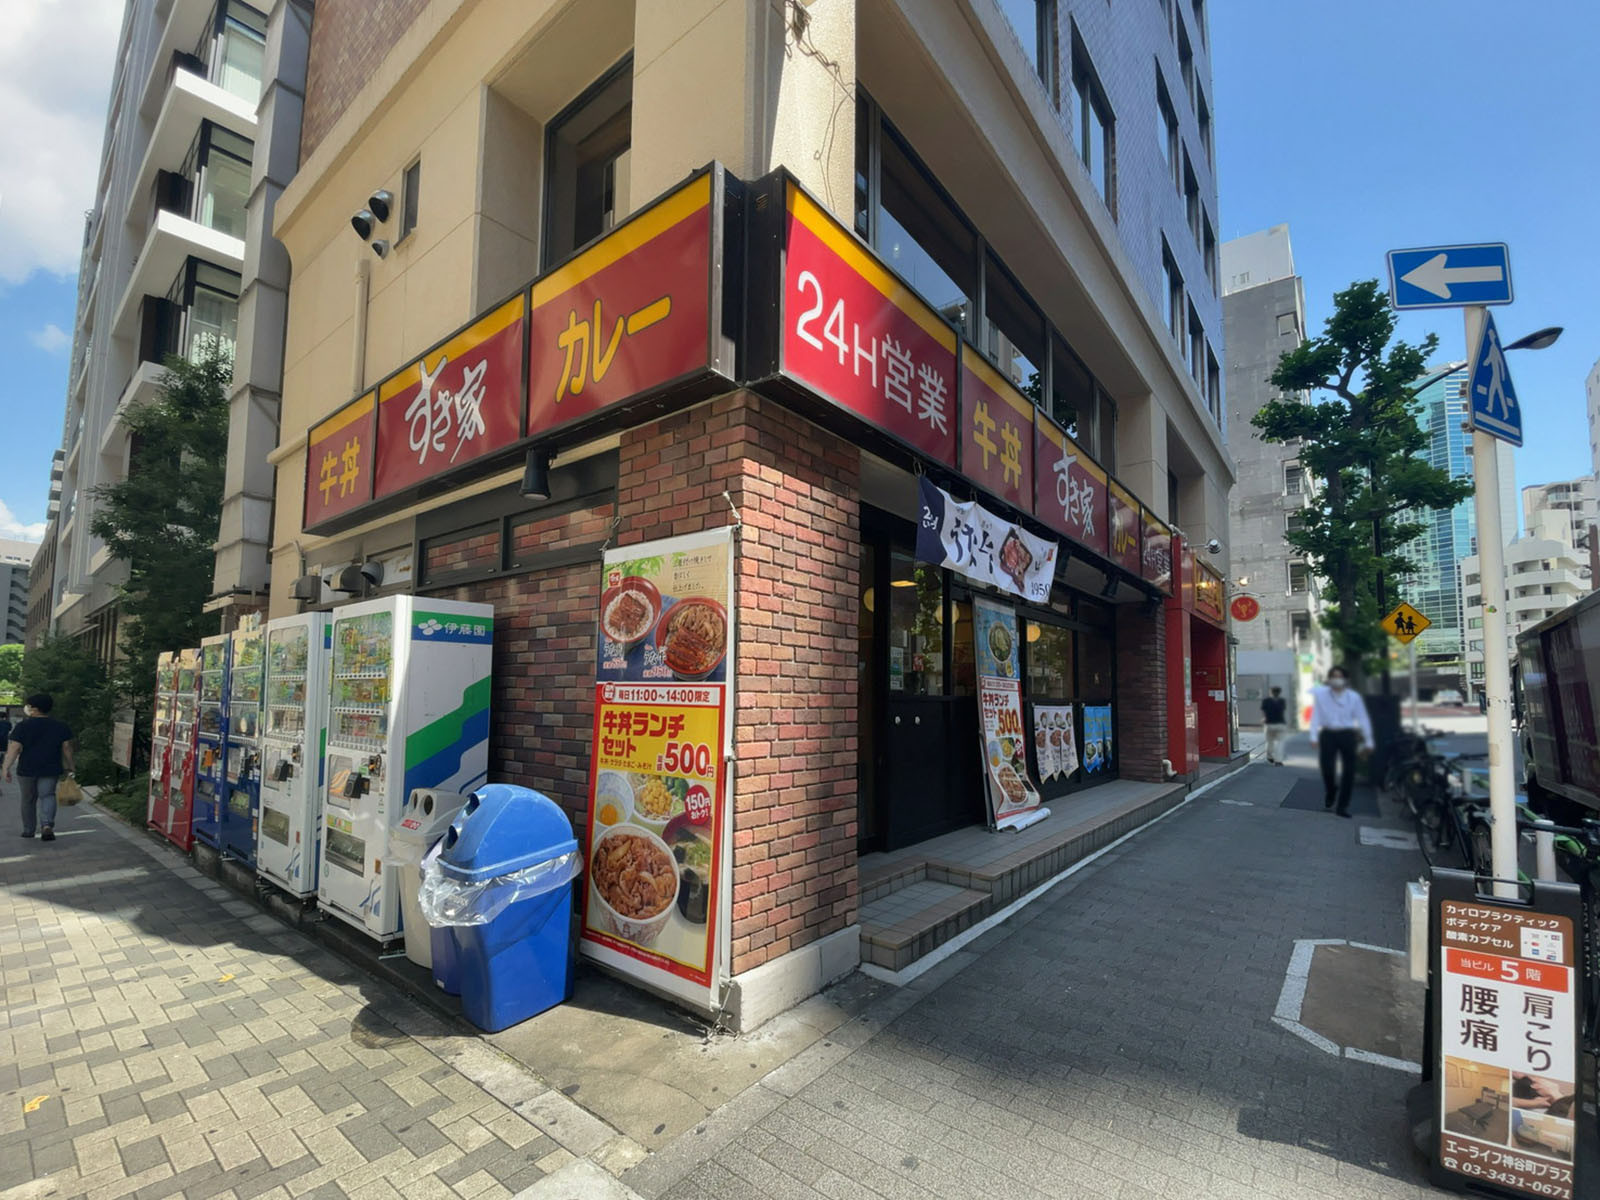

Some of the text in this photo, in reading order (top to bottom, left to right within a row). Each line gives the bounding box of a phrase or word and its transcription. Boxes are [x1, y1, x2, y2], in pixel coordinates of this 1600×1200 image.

[555, 295, 672, 404] カレー
[796, 270, 948, 436] 24H営業
[404, 355, 489, 465] すき家
[973, 399, 1022, 489] 牛丼
[319, 436, 360, 506] 牛丼
[1053, 437, 1096, 541] すき家
[1113, 530, 1136, 554] カレー
[445, 622, 486, 637] 伊藤園
[602, 710, 685, 739] 牛丼ランチ
[601, 736, 637, 759] セット
[664, 742, 714, 778] 500円
[685, 792, 711, 811] 150円
[1446, 904, 1559, 930] カイロプラクティック
[1446, 916, 1502, 933] ボディケア
[1446, 929, 1514, 949] 酸素カプセル
[1460, 983, 1500, 1053] 腰痛
[1522, 991, 1555, 1073] 肩こり
[1446, 1139, 1573, 1184] エーライフ神谷町プラス
[1462, 1161, 1571, 1200] 03-3431-0671
